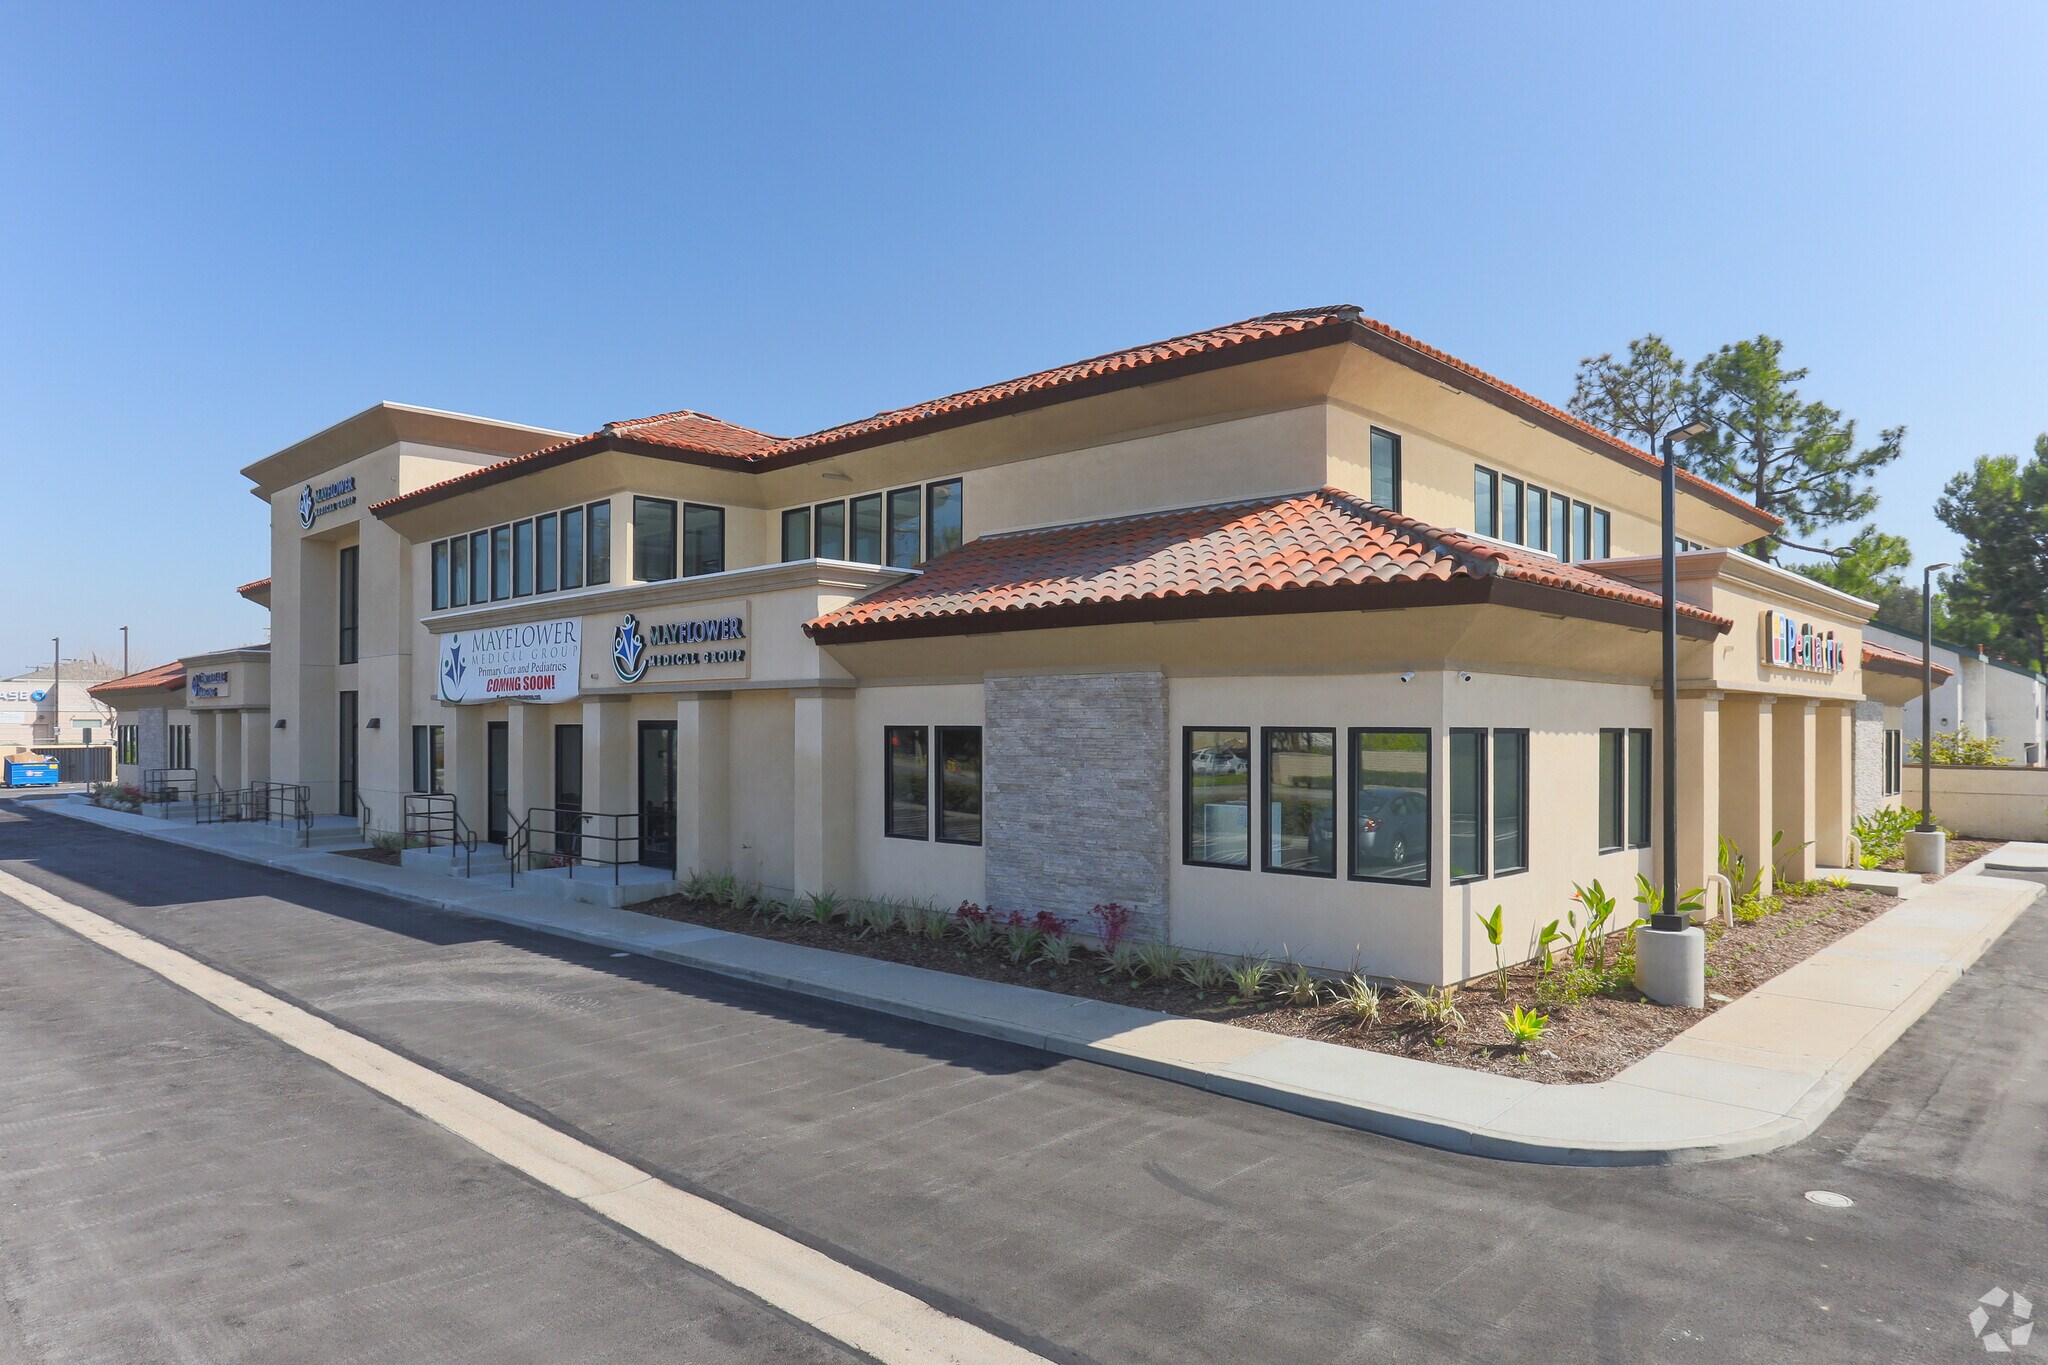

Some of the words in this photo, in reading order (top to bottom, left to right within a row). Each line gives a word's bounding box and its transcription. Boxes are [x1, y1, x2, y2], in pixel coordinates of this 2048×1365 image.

[472, 621, 577, 653] MAYFLOWER
[650, 617, 744, 645] MAYFLOWER
[472, 650, 523, 665] MEDICAL
[532, 646, 578, 660] GROUP
[648, 653, 698, 666] MEDICAL
[703, 650, 744, 664] GROUP
[478, 666, 502, 678] Primary
[517, 663, 530, 674] and
[531, 662, 567, 673] Pediatrics
[486, 677, 521, 693] COMING
[523, 675, 556, 690] SOON!
